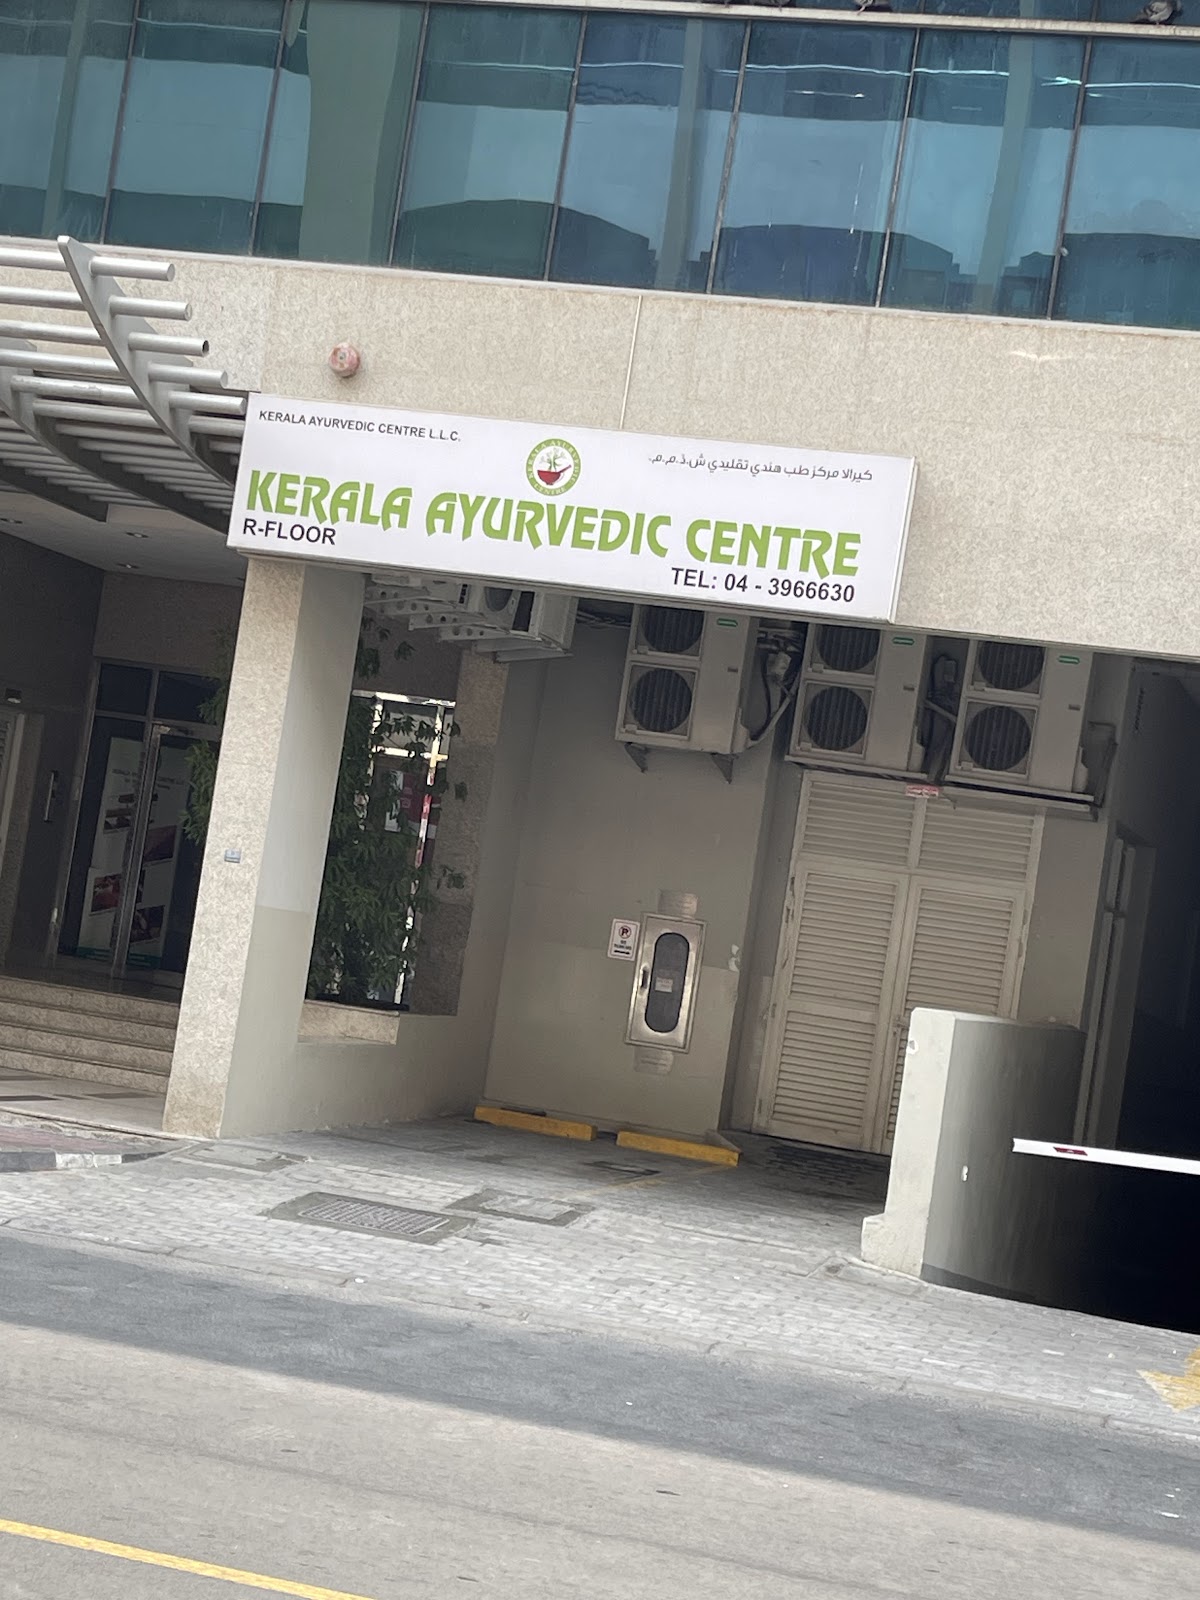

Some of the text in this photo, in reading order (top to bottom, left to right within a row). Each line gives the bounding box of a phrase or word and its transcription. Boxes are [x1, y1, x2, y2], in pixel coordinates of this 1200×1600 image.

[258, 410, 462, 442] KERALA AYURVEDIC CENTRE L.L.C.
[707, 458, 749, 472] تقليدي
[750, 463, 782, 477] هندي
[783, 465, 810, 478] طب
[811, 465, 839, 480] مركز
[841, 467, 873, 484] كيرالا
[242, 517, 336, 546] R-FLOOR
[247, 470, 860, 579] KERALA AYURVEDIC CENTRE
[671, 567, 718, 590] TEL:
[724, 573, 748, 593] 04
[767, 577, 855, 603] 3966630
